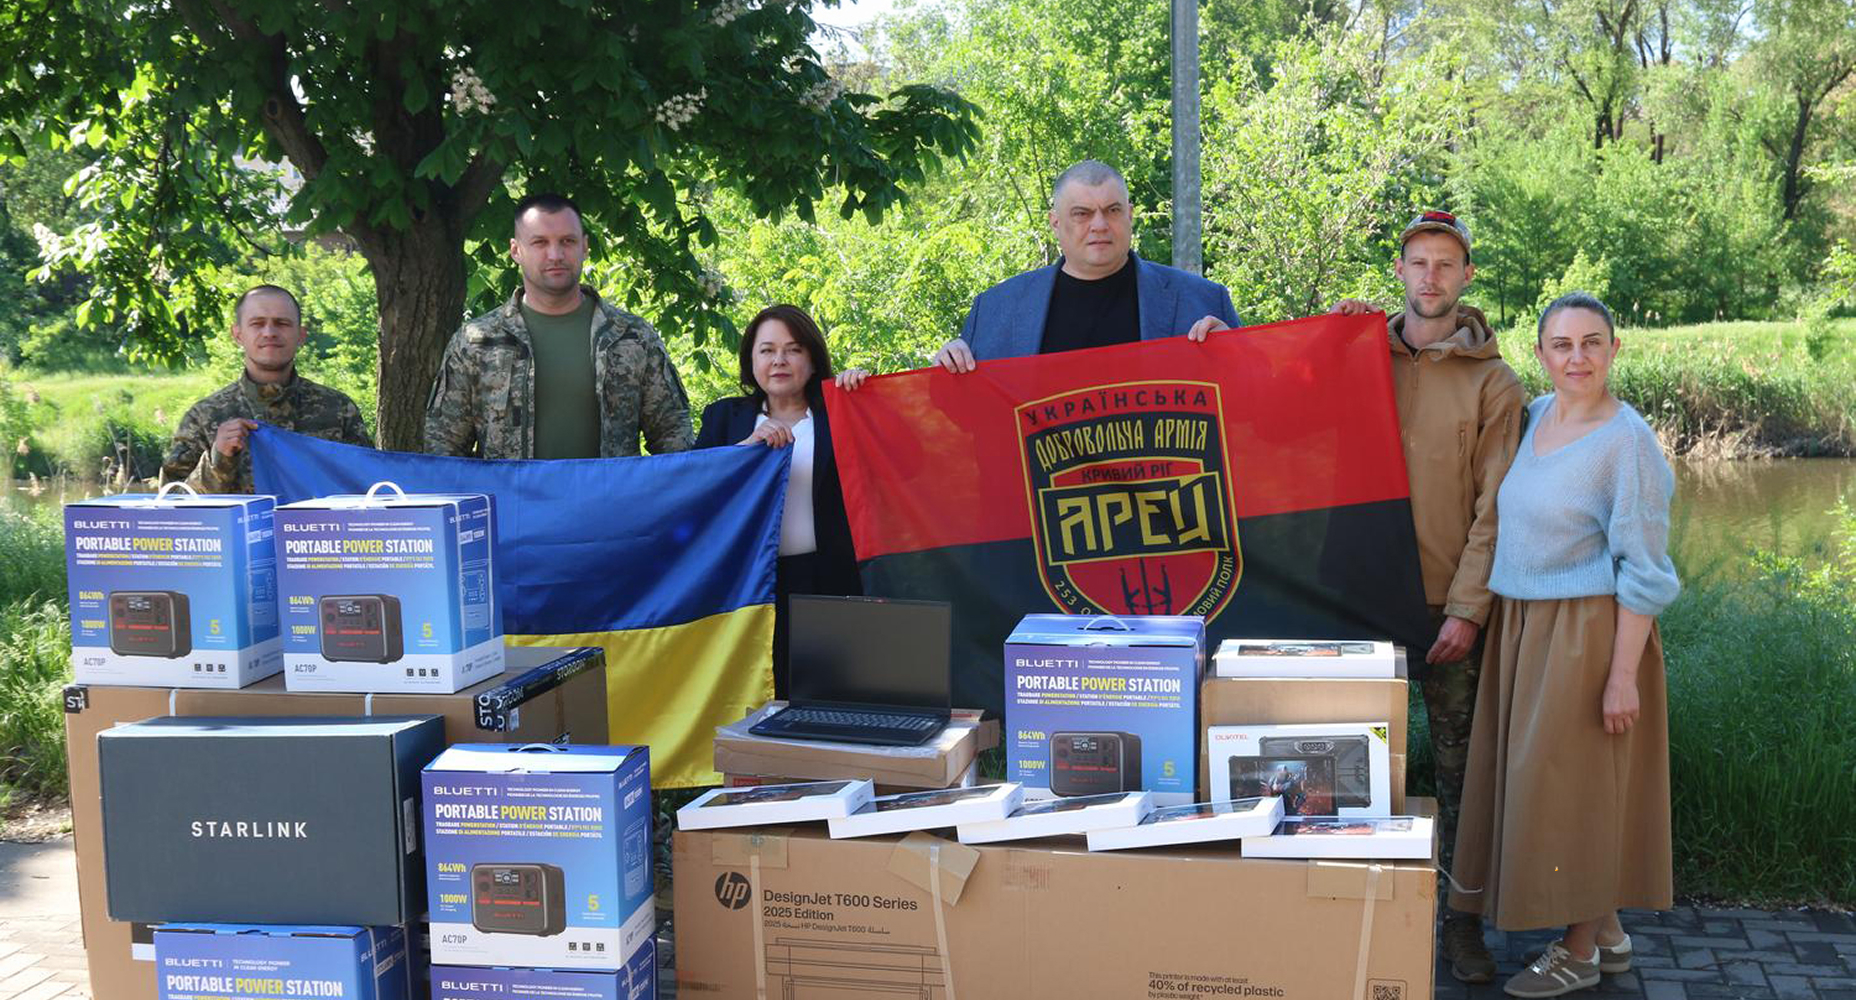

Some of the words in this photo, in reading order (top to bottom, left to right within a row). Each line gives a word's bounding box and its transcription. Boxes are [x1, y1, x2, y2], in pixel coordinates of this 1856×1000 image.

[1025, 389, 1208, 425] УКРАЇНСЬКА
[1154, 418, 1208, 451] АРМІЯ
[1081, 463, 1146, 483] КРИВИЙ
[1151, 462, 1173, 477] РІГ
[74, 521, 130, 529] BLUETTI
[284, 523, 340, 532] BLUETTI
[76, 537, 131, 551] PORTABLE
[133, 537, 174, 551] POWER
[175, 538, 222, 552] STATION
[286, 540, 341, 554] PORTABLE
[343, 540, 384, 553] POWER
[385, 539, 433, 553] STATION
[1055, 580, 1077, 605] 253
[1217, 556, 1233, 589] ПОЛК
[289, 596, 315, 606] 864Wh
[210, 619, 221, 635] 5
[292, 625, 316, 635] 1000W
[423, 622, 433, 637] 5
[1015, 658, 1079, 668] BLUETTI
[1017, 675, 1079, 690] PORTABLE
[1081, 676, 1127, 691] POWER
[1129, 678, 1181, 693] STATION
[1018, 730, 1045, 740] 864Wh
[1019, 760, 1045, 770] 1000W
[1163, 761, 1175, 777] 5
[433, 787, 497, 796] BLUETTI
[435, 804, 499, 819] PORTABLE
[500, 806, 547, 821] POWER
[549, 807, 602, 822] STATION
[191, 821, 308, 838] STARLINK
[438, 863, 466, 873] 864Wh
[719, 872, 749, 910] hp
[440, 894, 467, 904] 1000W
[588, 894, 599, 912] 5
[764, 890, 832, 906] DesignJet
[835, 894, 870, 908] T600
[873, 896, 918, 911] Series
[763, 906, 792, 918] 2025
[795, 908, 834, 921] Edition
[764, 920, 781, 928] 2025
[812, 923, 847, 932] DesignJet
[848, 925, 866, 933] T600
[442, 935, 467, 944] AC70P
[165, 958, 223, 968] BLUETTI
[167, 975, 233, 992] PORTABLE
[235, 977, 283, 994] POWER
[286, 980, 343, 997] STATION
[441, 981, 503, 991] BLUETTI
[1148, 980, 1175, 990] 40%
[1177, 981, 1189, 991] of
[1191, 983, 1242, 995] recycled
[1244, 986, 1284, 997] plastic
